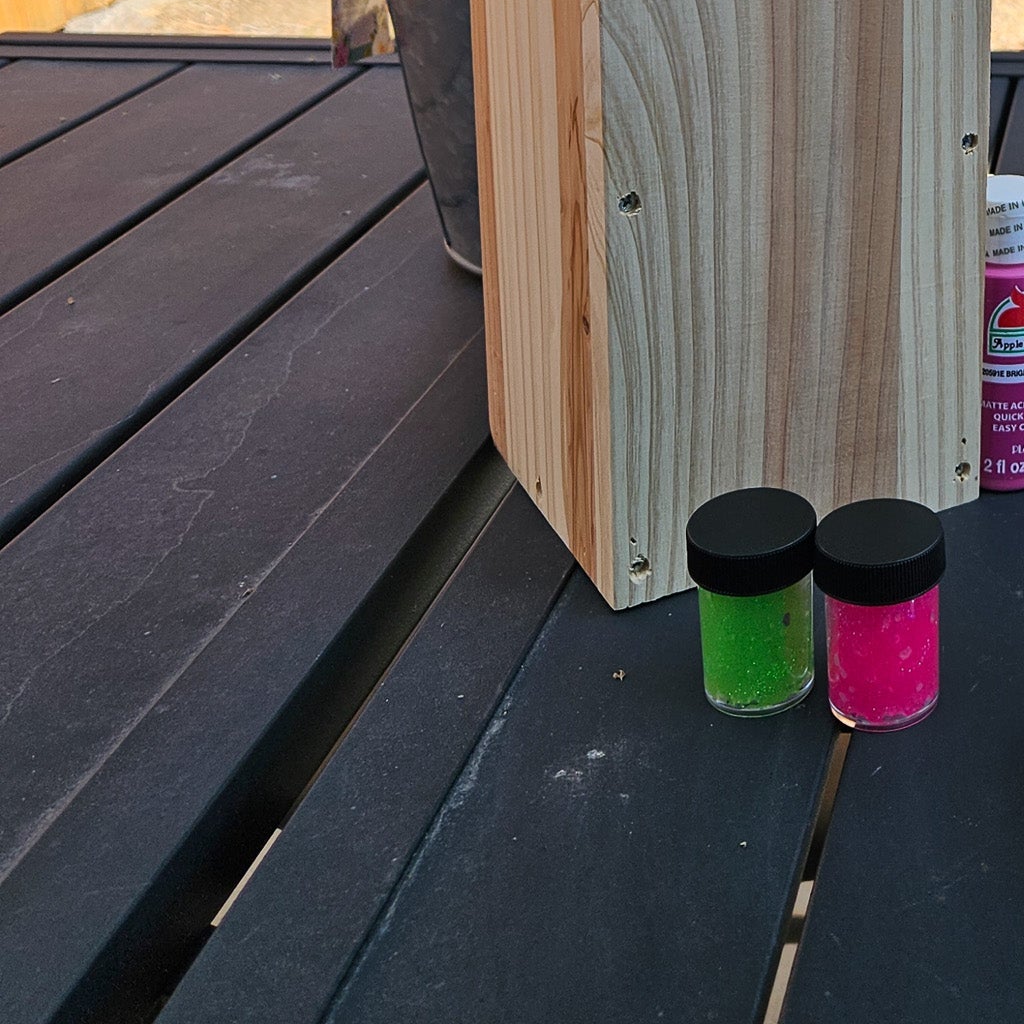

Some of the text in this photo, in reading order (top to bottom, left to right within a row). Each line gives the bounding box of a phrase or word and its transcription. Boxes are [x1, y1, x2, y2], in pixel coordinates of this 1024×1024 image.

[1008, 201, 1019, 210] IN
[989, 226, 1011, 236] MADE
[1013, 223, 1023, 232] IN
[993, 246, 1015, 256] MADE
[992, 338, 1024, 351] Apple
[993, 412, 1024, 422] QUICK
[992, 424, 1017, 432] EASY
[984, 458, 993, 473] 2
[996, 459, 1006, 474] fl
